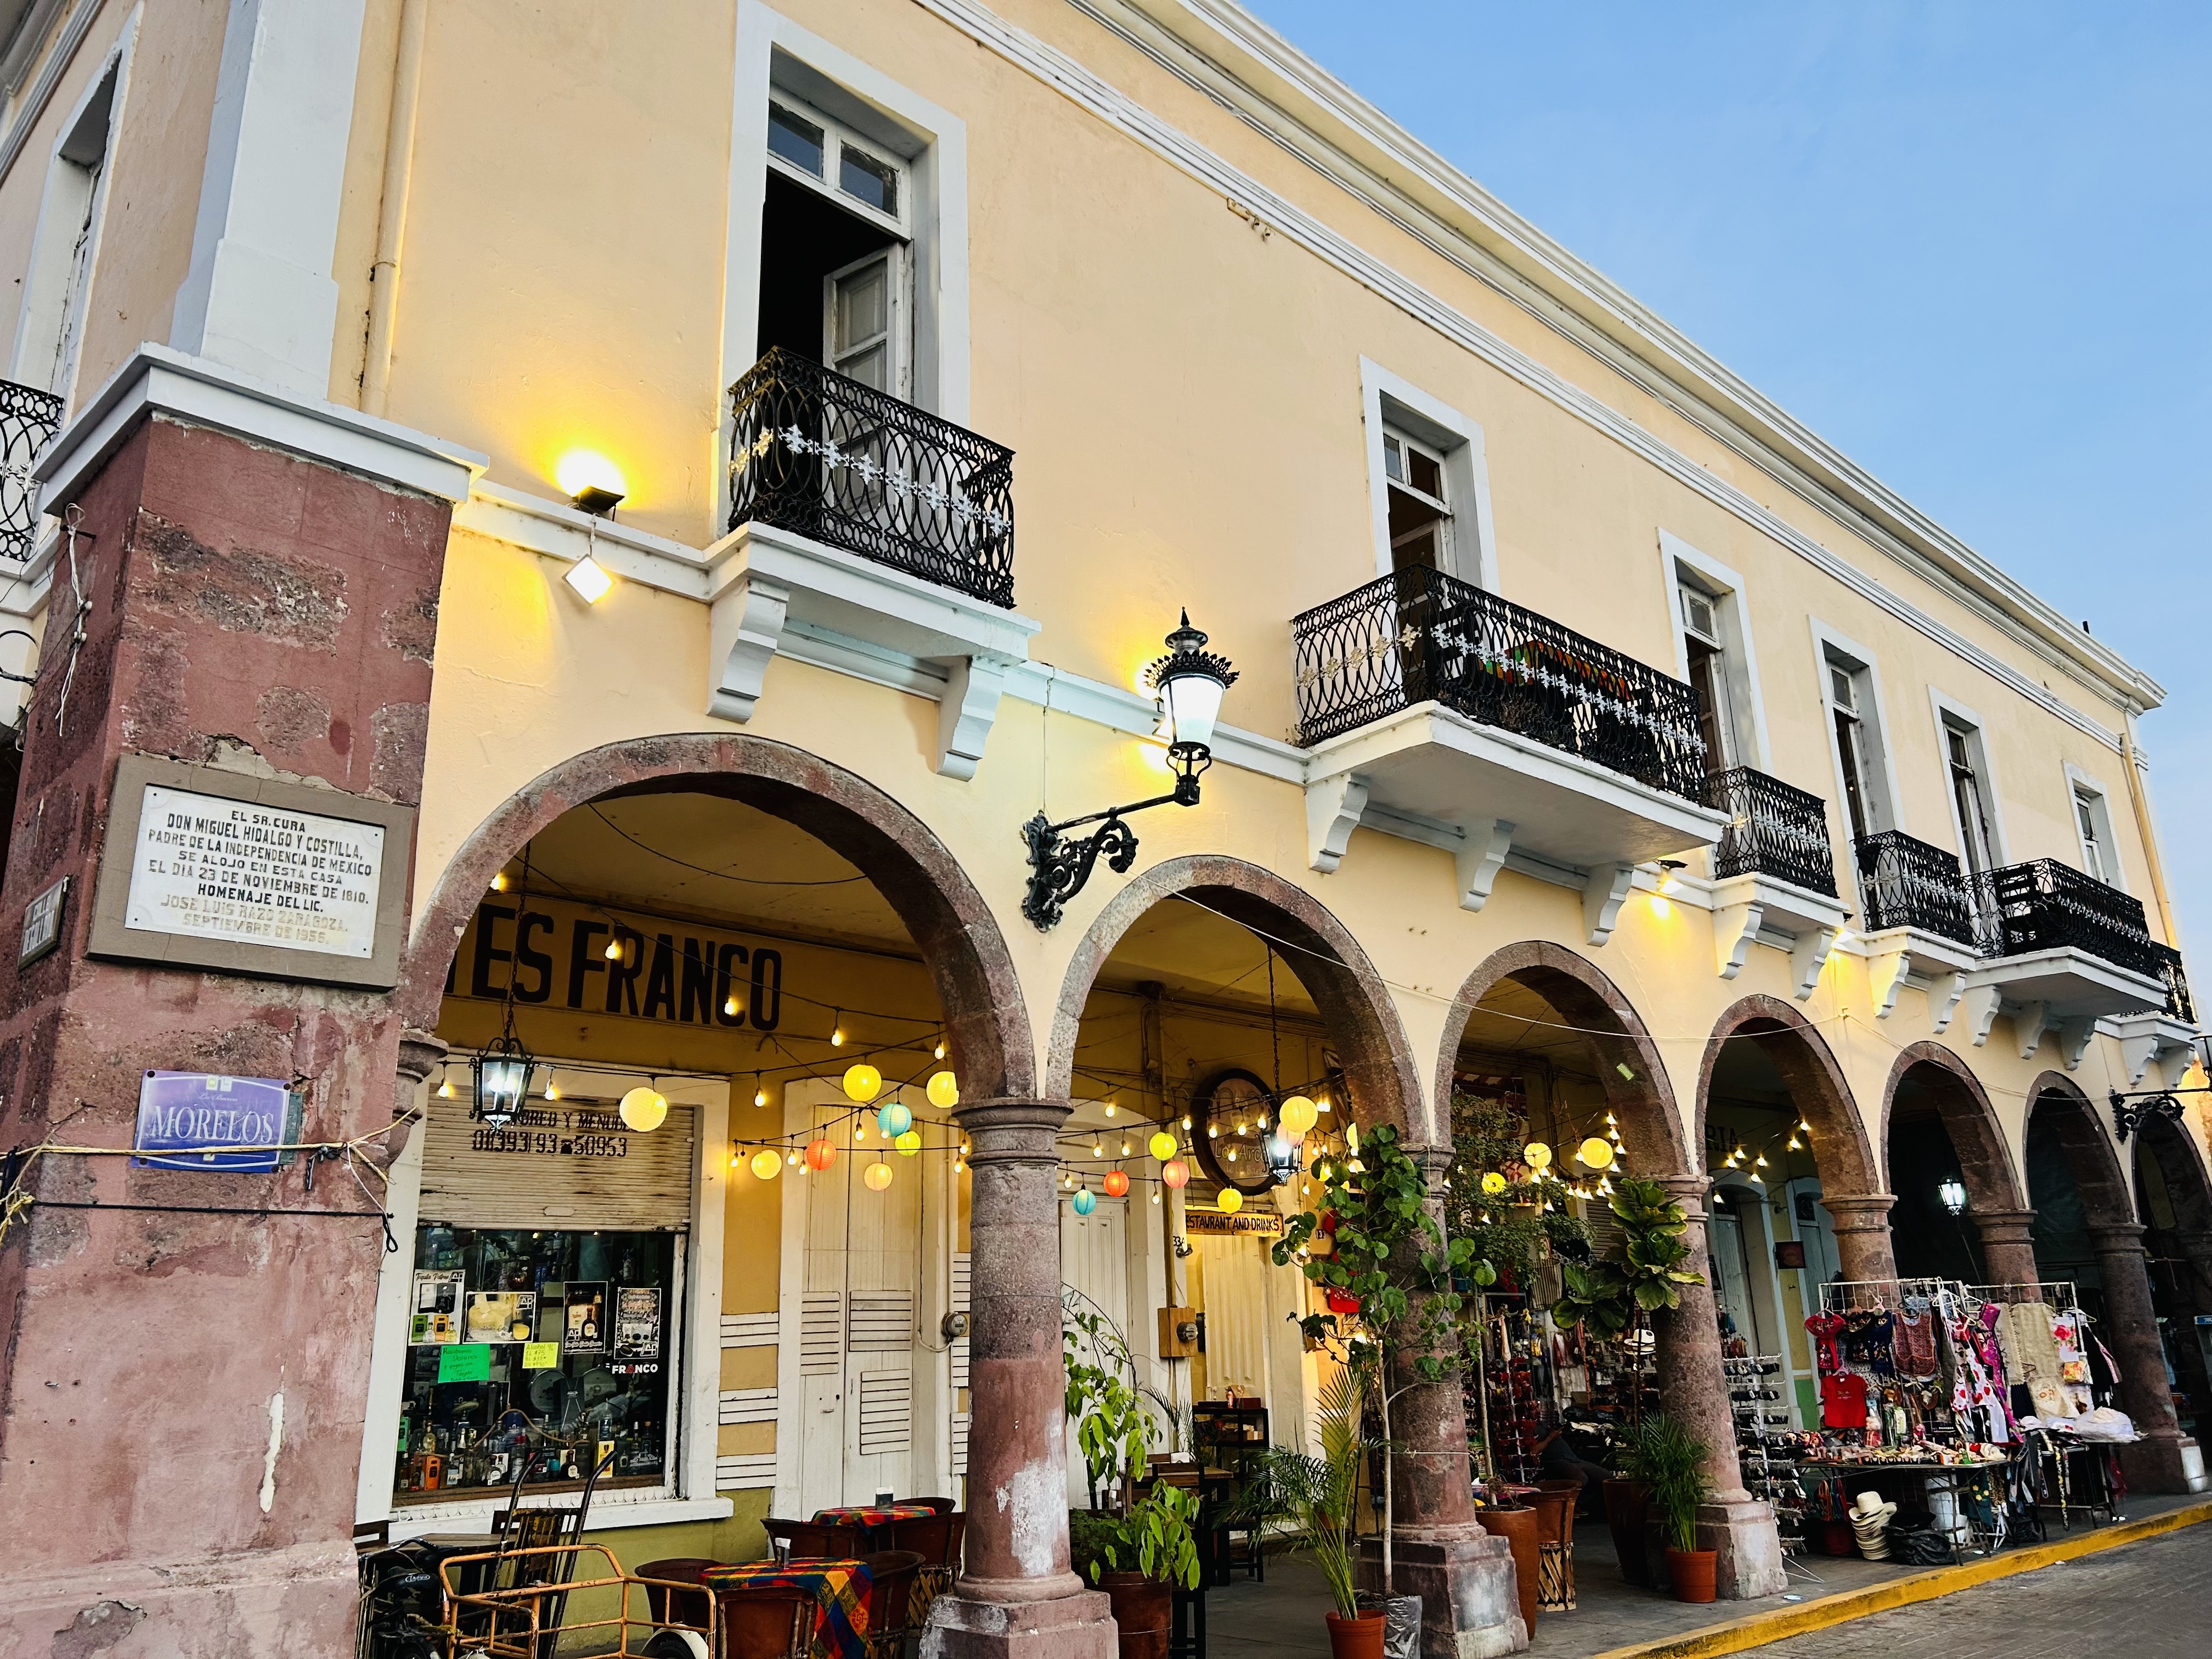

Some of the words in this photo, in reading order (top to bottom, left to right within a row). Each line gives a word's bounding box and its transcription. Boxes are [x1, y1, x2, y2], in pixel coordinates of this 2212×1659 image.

[231, 810, 247, 822] EL
[274, 818, 305, 832] CURA
[167, 813, 191, 831] DON
[195, 818, 239, 839] MIGUEL
[243, 826, 292, 847] HIDALGO
[297, 834, 303, 849] Y
[306, 836, 363, 861] COSTILLA,
[148, 829, 187, 846] PADRE
[189, 836, 204, 849] DE
[208, 839, 221, 852] LA
[225, 841, 307, 866] INDEPENDENCIA
[312, 855, 326, 869] DE
[329, 859, 371, 876] MEXICO
[178, 850, 196, 861] SE
[202, 855, 245, 869] ALOJO
[251, 862, 267, 873] EN
[273, 865, 304, 879] ESTA
[311, 872, 342, 884] CASA
[148, 859, 166, 873] EL
[172, 863, 193, 878] DIA
[199, 867, 216, 881] 23
[222, 871, 239, 884] DE
[243, 874, 318, 896] NOVIEMBRE
[322, 886, 338, 899] DE
[160, 894, 198, 910] JOSE
[203, 900, 235, 915] LUIS
[198, 883, 272, 905] HOMENAJE
[276, 895, 300, 909] DEL
[303, 899, 323, 912] LIC.
[275, 925, 292, 938] DE
[567, 919, 782, 1031] FRANCO
[150, 1105, 274, 1143] MORELOS
[574, 1135, 628, 1157] 50953
[1233, 1216, 1250, 1231] AND
[612, 1363, 658, 1374] FRANCO
